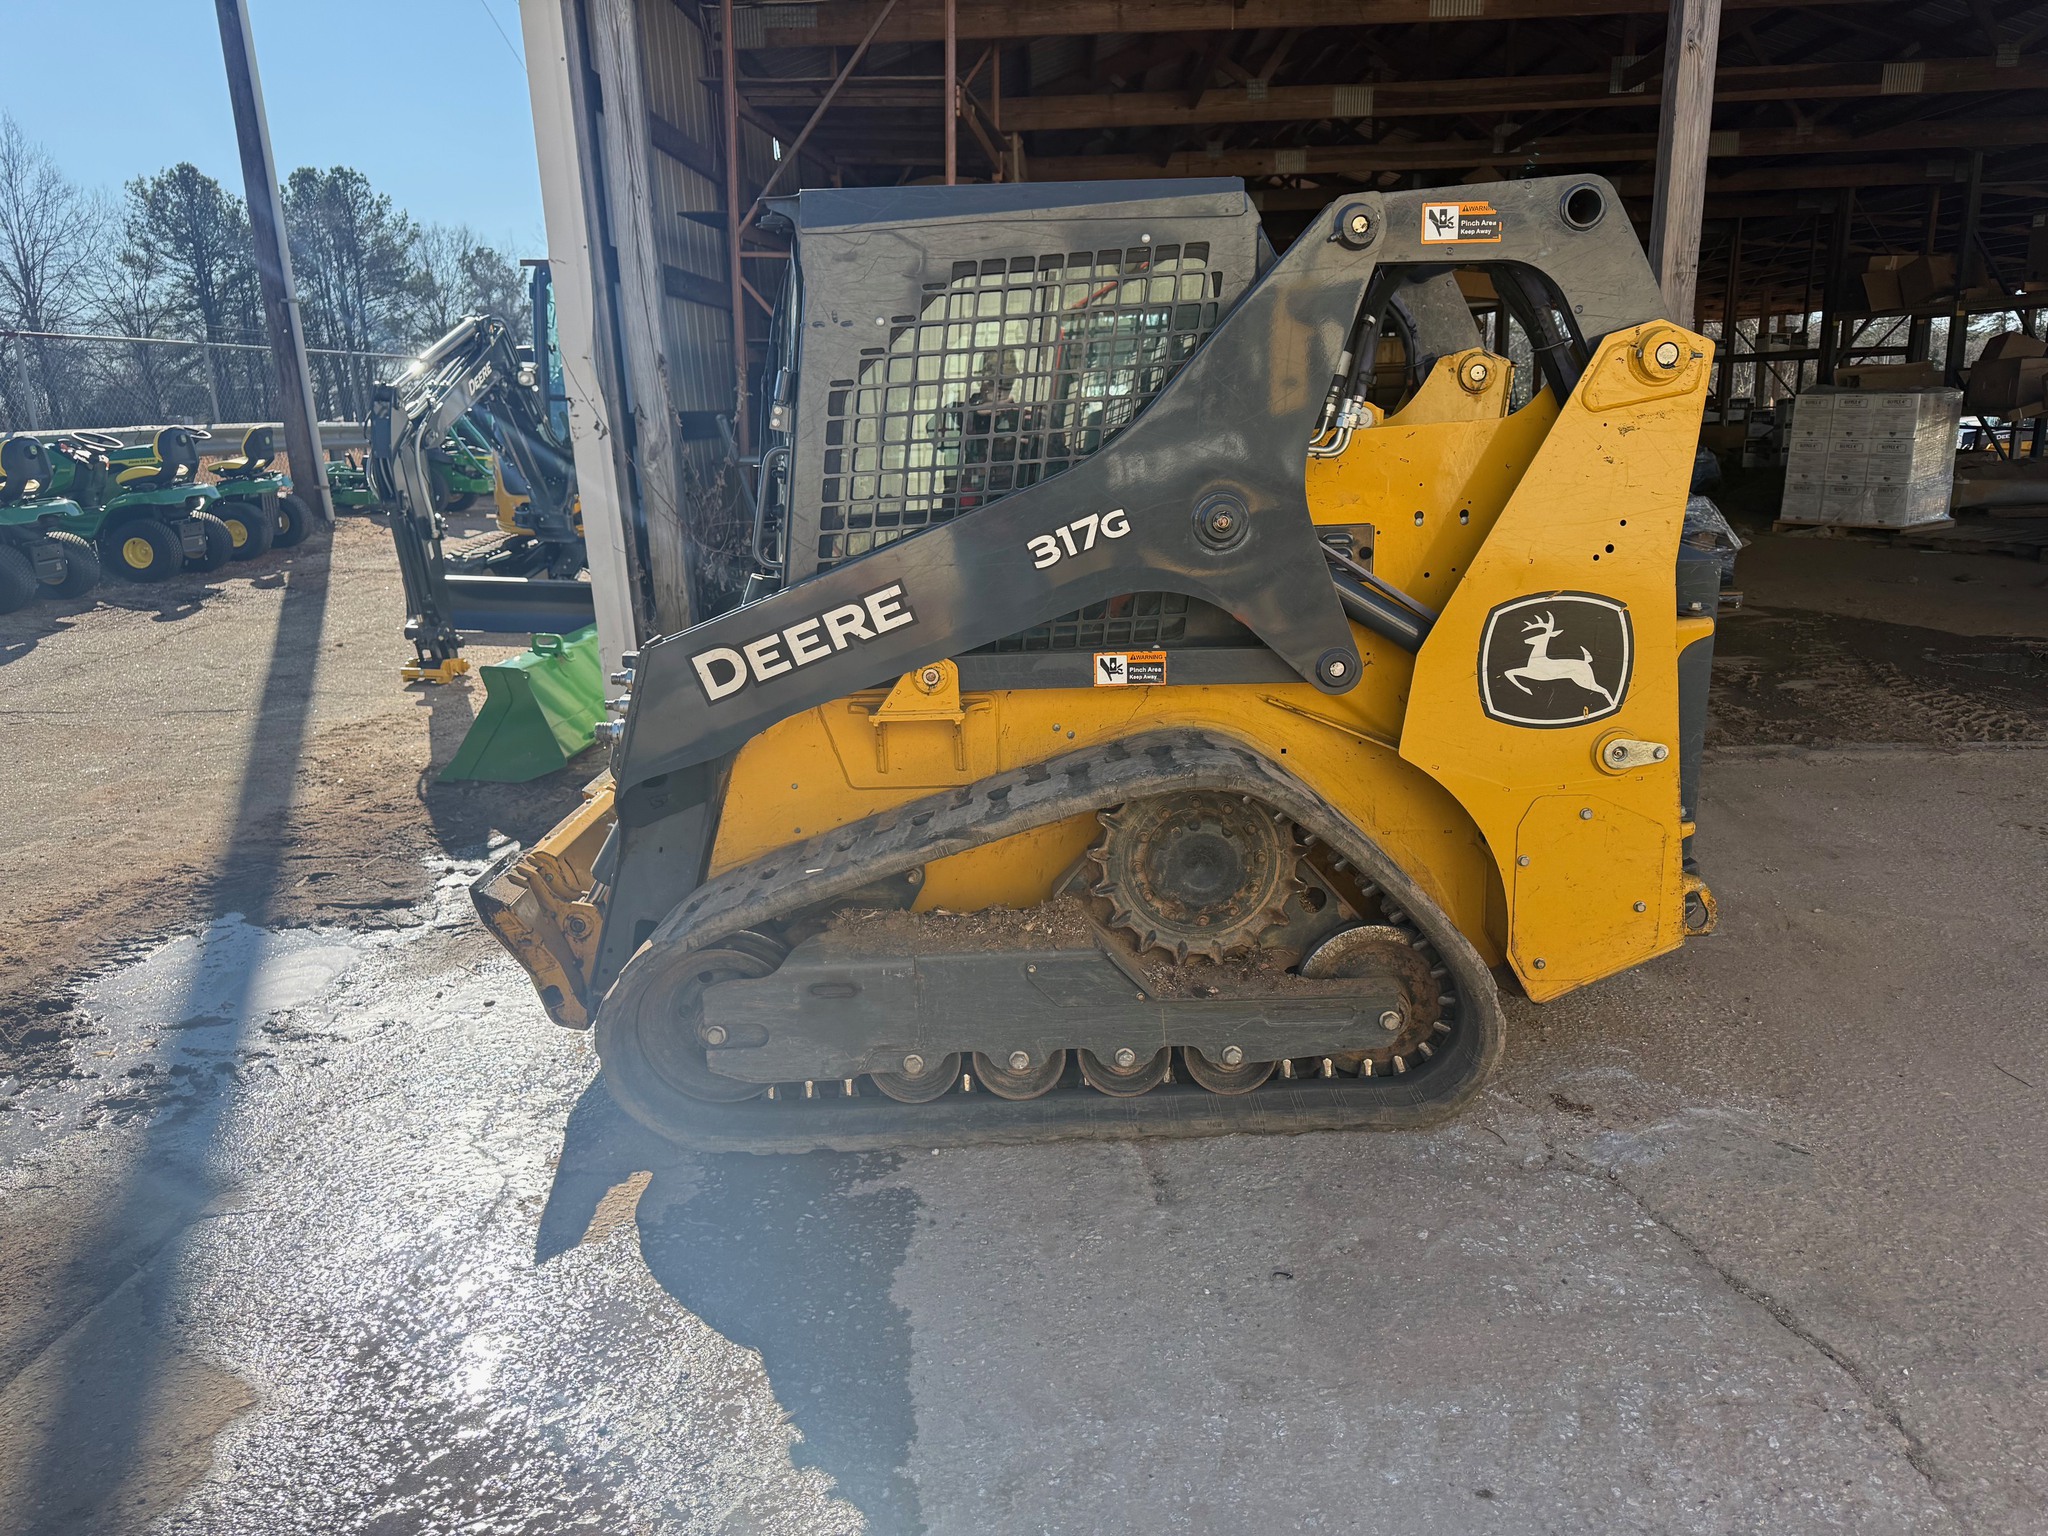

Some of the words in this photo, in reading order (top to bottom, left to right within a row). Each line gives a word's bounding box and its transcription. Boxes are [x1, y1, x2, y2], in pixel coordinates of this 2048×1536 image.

[468, 360, 493, 397] DEERE
[1026, 508, 1131, 569] 317G
[691, 584, 914, 701] DEERE
